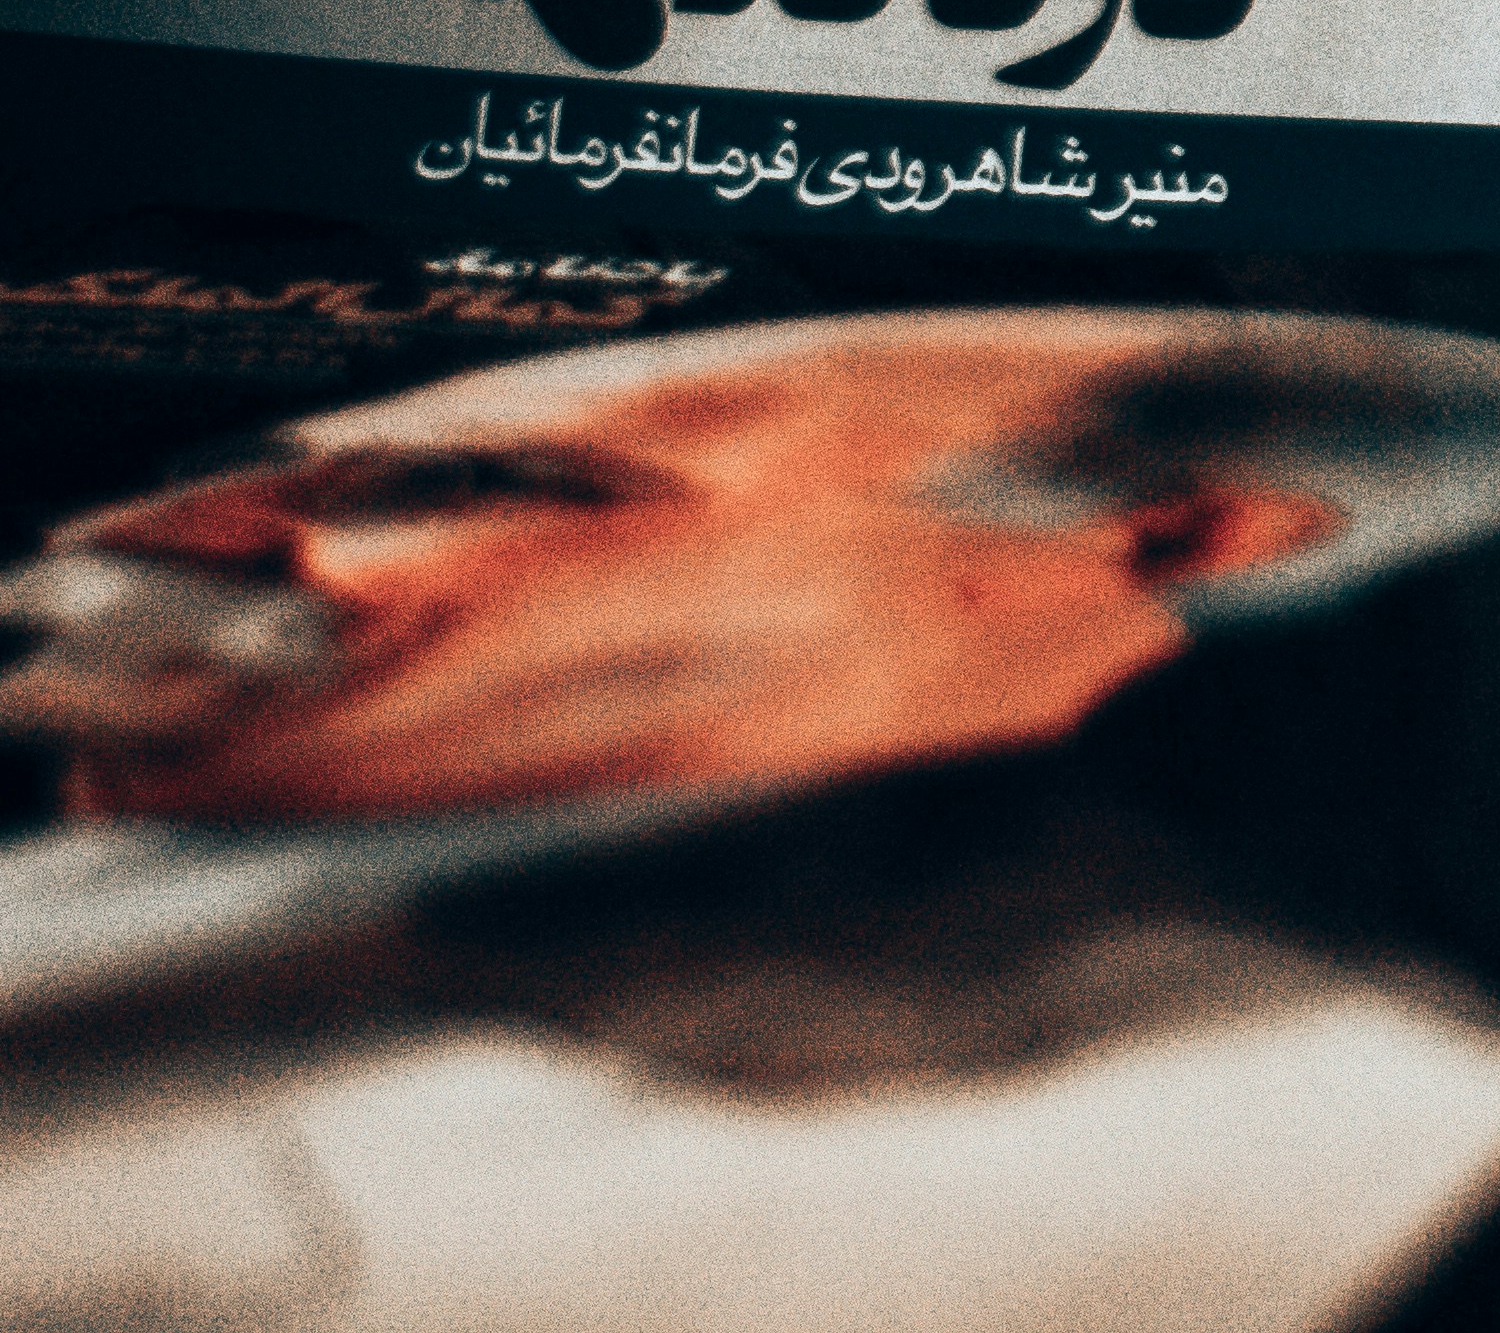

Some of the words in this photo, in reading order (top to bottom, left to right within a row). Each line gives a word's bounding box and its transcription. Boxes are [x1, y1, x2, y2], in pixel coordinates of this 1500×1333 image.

[414, 90, 799, 205] فرمانفرمائیان
[800, 125, 1098, 220] شاهرودی
[1088, 141, 1230, 229] منیر
